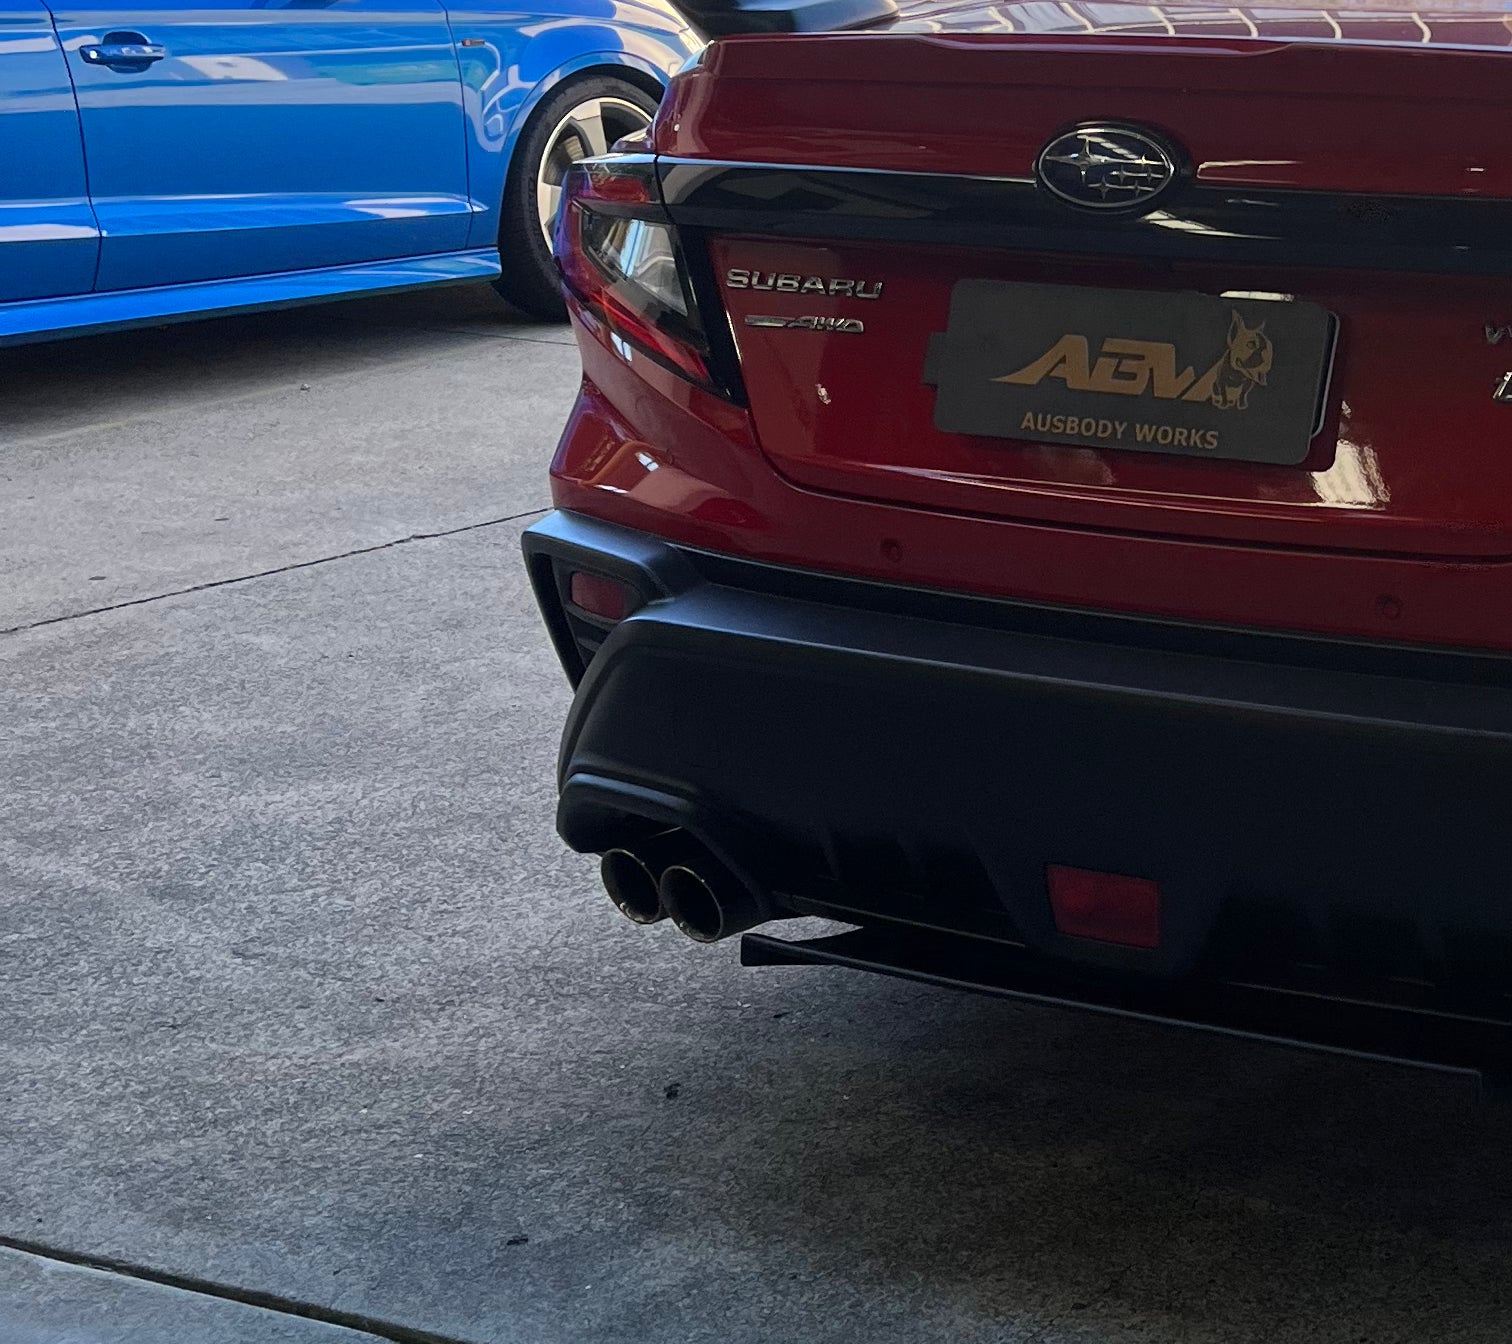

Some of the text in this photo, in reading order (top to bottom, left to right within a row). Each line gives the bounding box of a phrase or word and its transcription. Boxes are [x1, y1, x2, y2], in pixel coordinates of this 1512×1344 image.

[726, 268, 883, 300] SUBARU
[788, 315, 864, 334] AWD
[1021, 411, 1219, 450] AUSBODY WORKS
